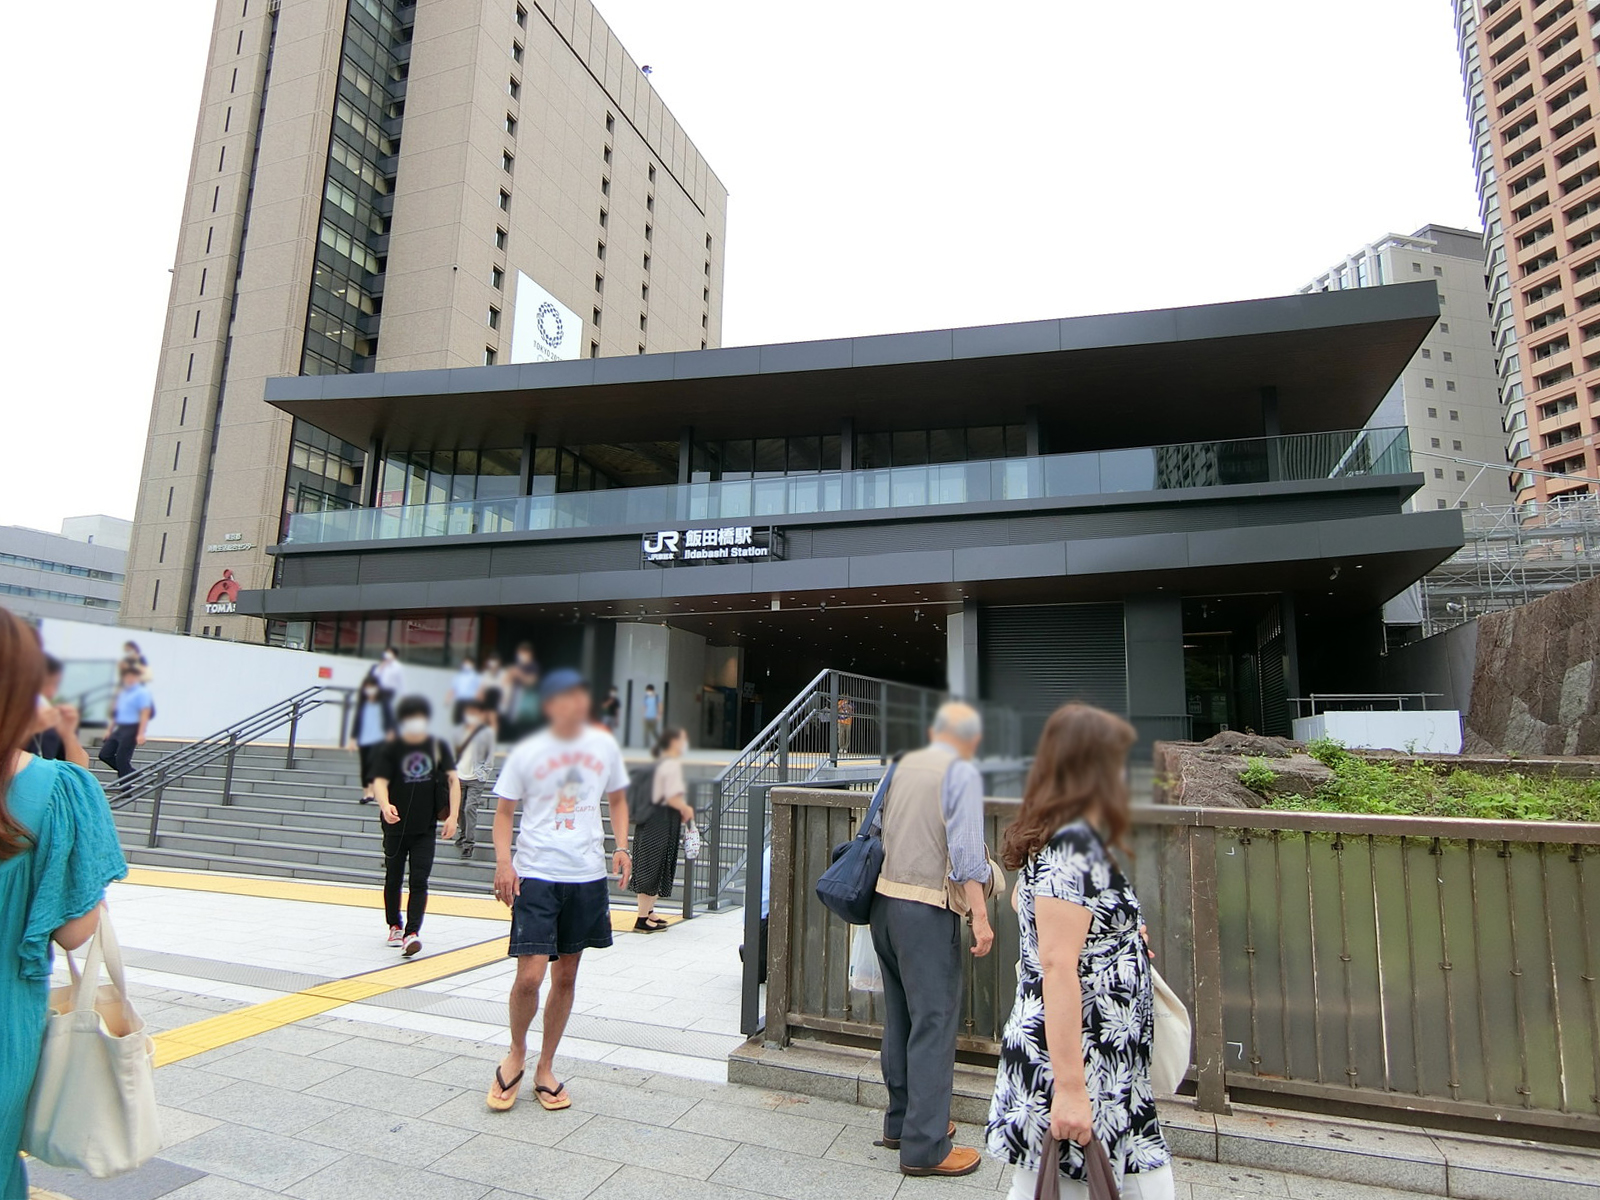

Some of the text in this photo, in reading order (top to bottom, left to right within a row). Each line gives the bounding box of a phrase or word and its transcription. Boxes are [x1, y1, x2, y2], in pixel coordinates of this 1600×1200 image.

[533, 340, 550, 357] TOKYO
[644, 530, 680, 553] JR
[685, 527, 752, 546] 飯田橋駅
[684, 546, 768, 559] Iidabashi Station
